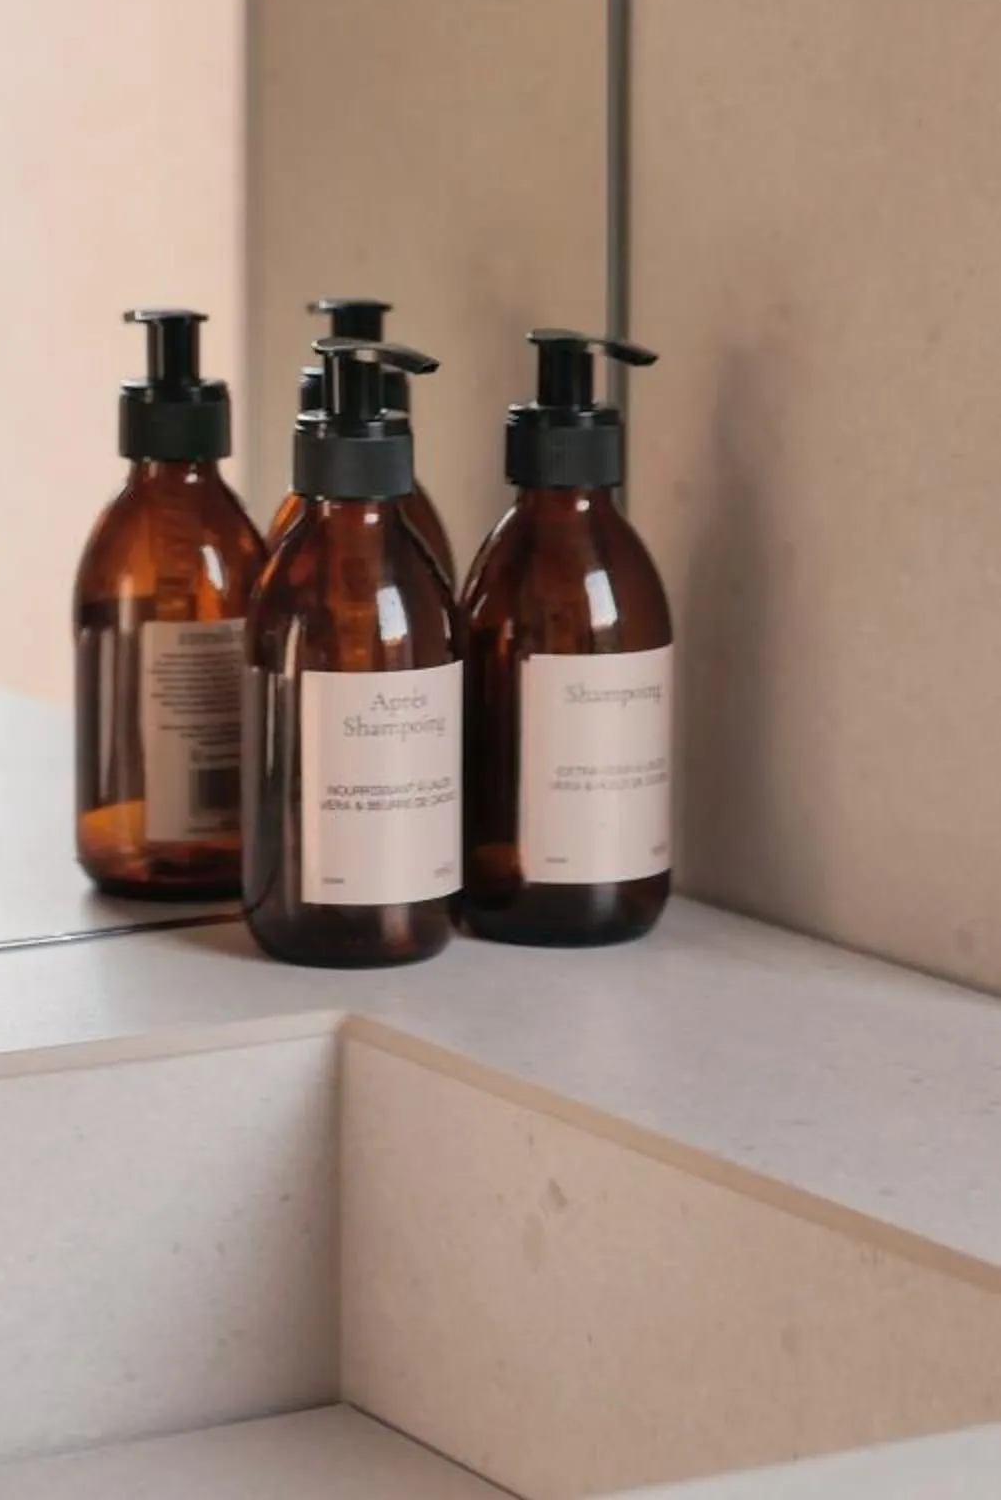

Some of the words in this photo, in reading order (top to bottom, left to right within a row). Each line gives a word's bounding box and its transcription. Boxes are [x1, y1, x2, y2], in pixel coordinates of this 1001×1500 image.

[370, 686, 427, 715] Après
[565, 682, 662, 710] Shampoing
[342, 714, 447, 742] Shampoing
